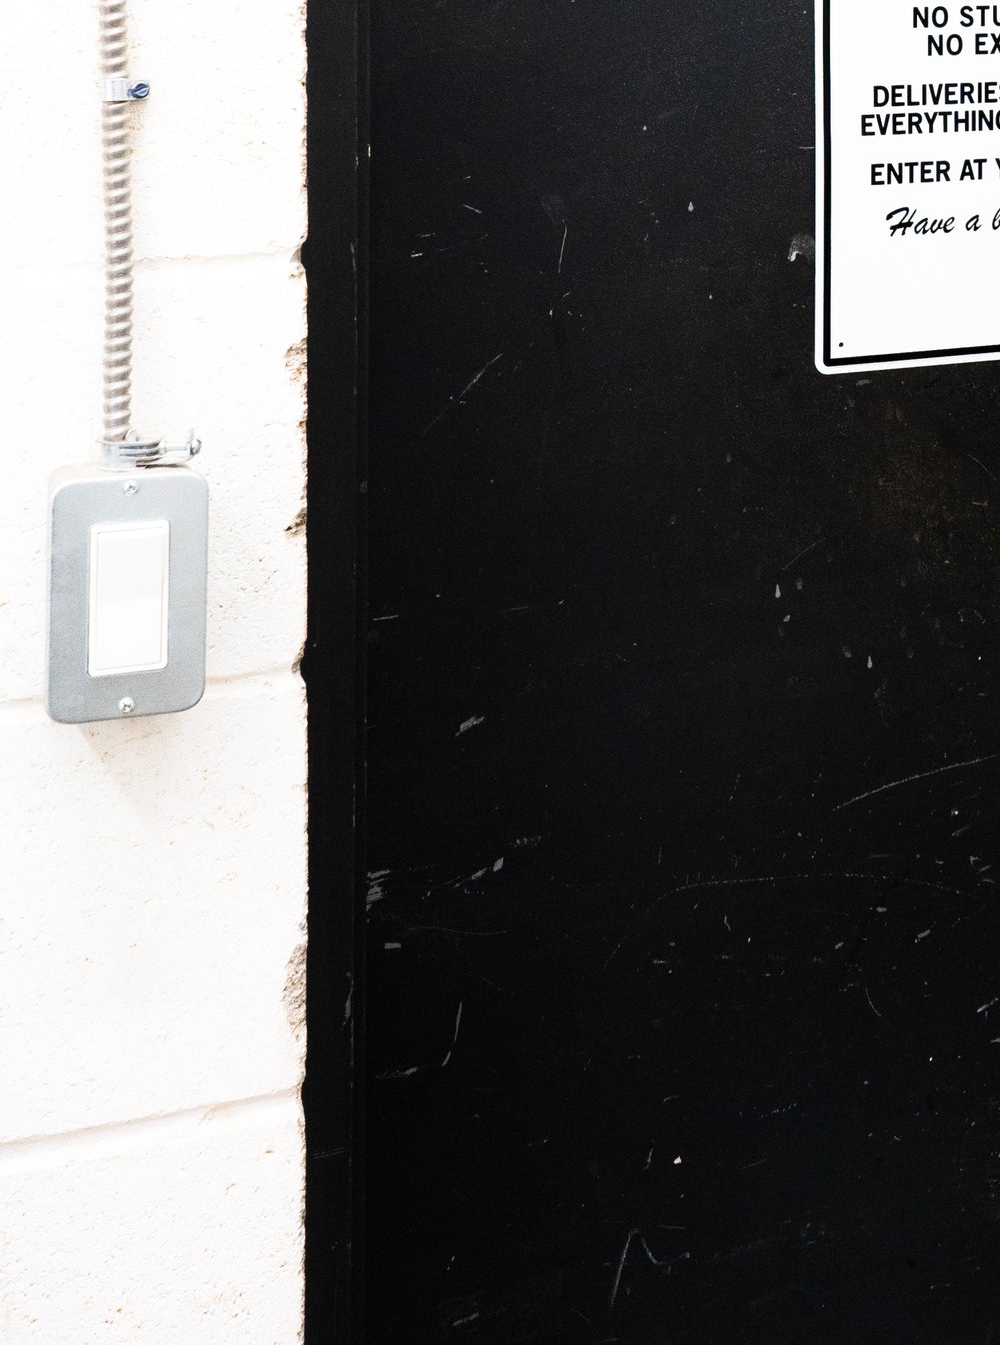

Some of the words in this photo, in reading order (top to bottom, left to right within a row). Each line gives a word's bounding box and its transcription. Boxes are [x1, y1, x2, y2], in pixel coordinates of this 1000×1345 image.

[913, 6, 948, 28] NO
[928, 34, 963, 56] NO
[871, 160, 950, 185] ENTER
[960, 159, 987, 181] AT
[886, 207, 955, 237] Have
[966, 215, 981, 231] a
